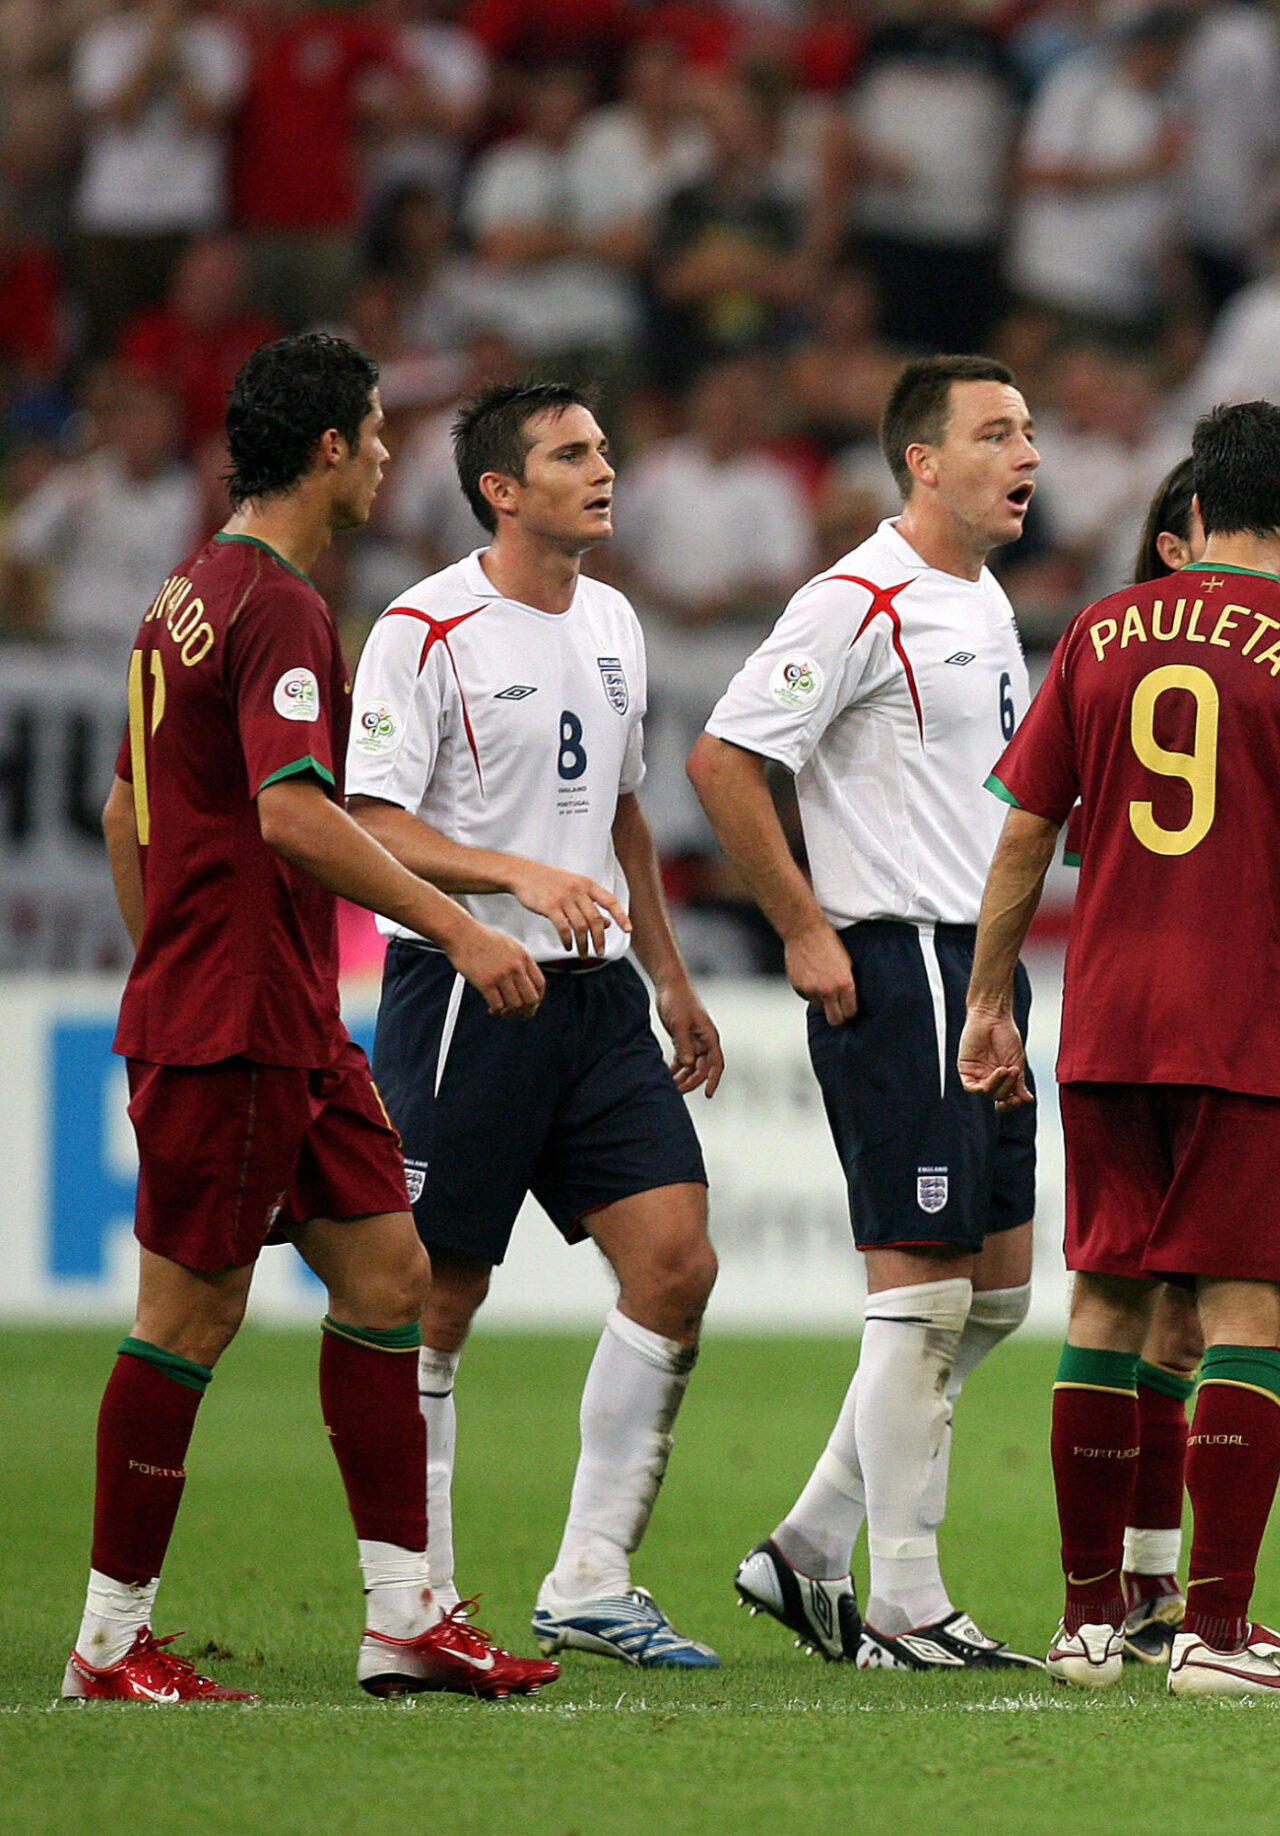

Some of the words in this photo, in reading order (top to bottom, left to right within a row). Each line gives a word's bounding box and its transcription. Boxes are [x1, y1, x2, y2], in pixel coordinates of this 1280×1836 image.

[1000, 671, 1015, 741] 6
[558, 709, 587, 780] 8
[1129, 664, 1220, 857] 9
